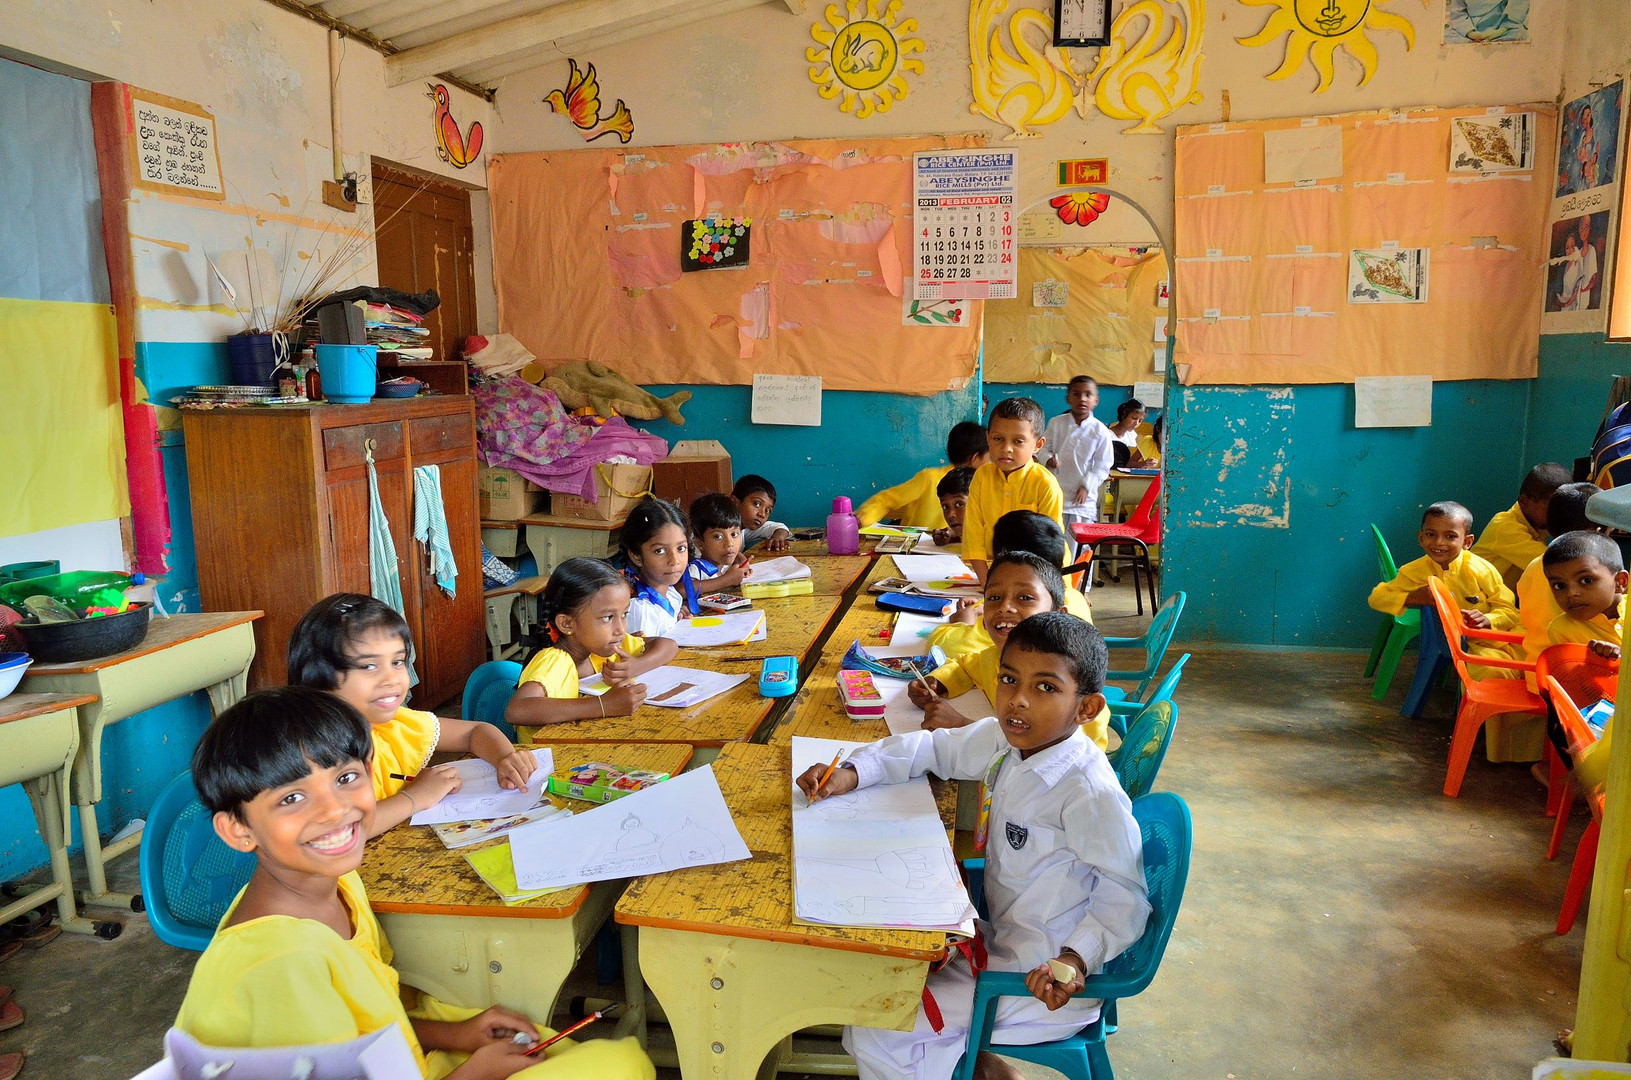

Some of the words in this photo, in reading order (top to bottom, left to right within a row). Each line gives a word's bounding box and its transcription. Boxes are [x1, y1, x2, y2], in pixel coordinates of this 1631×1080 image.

[929, 154, 1010, 163] ABEYSINGHE
[940, 197, 997, 205] FEBRUARY
[977, 213, 981, 222] 1
[990, 212, 995, 222] 2
[1004, 212, 1009, 222] 3
[923, 228, 928, 237] 4
[936, 228, 941, 237] 5
[950, 227, 955, 237] 6
[963, 227, 968, 237] 7
[976, 226, 982, 236] 8
[990, 226, 995, 236] 9
[1002, 225, 1012, 235] 10
[921, 242, 929, 251] 11
[934, 241, 944, 251] 12
[948, 241, 957, 251] 13
[961, 241, 971, 250] 14
[974, 240, 984, 250] 15
[988, 240, 997, 249] 16
[1002, 240, 1012, 249] 17
[921, 255, 930, 265] 18
[934, 255, 944, 264] 19
[947, 255, 957, 264] 20
[960, 254, 970, 264] 21
[974, 254, 984, 264] 22
[987, 254, 997, 263] 23
[1001, 253, 1012, 263] 24
[921, 269, 931, 278] 25
[934, 269, 944, 278] 26
[947, 268, 957, 278] 27
[960, 268, 971, 278] 28
